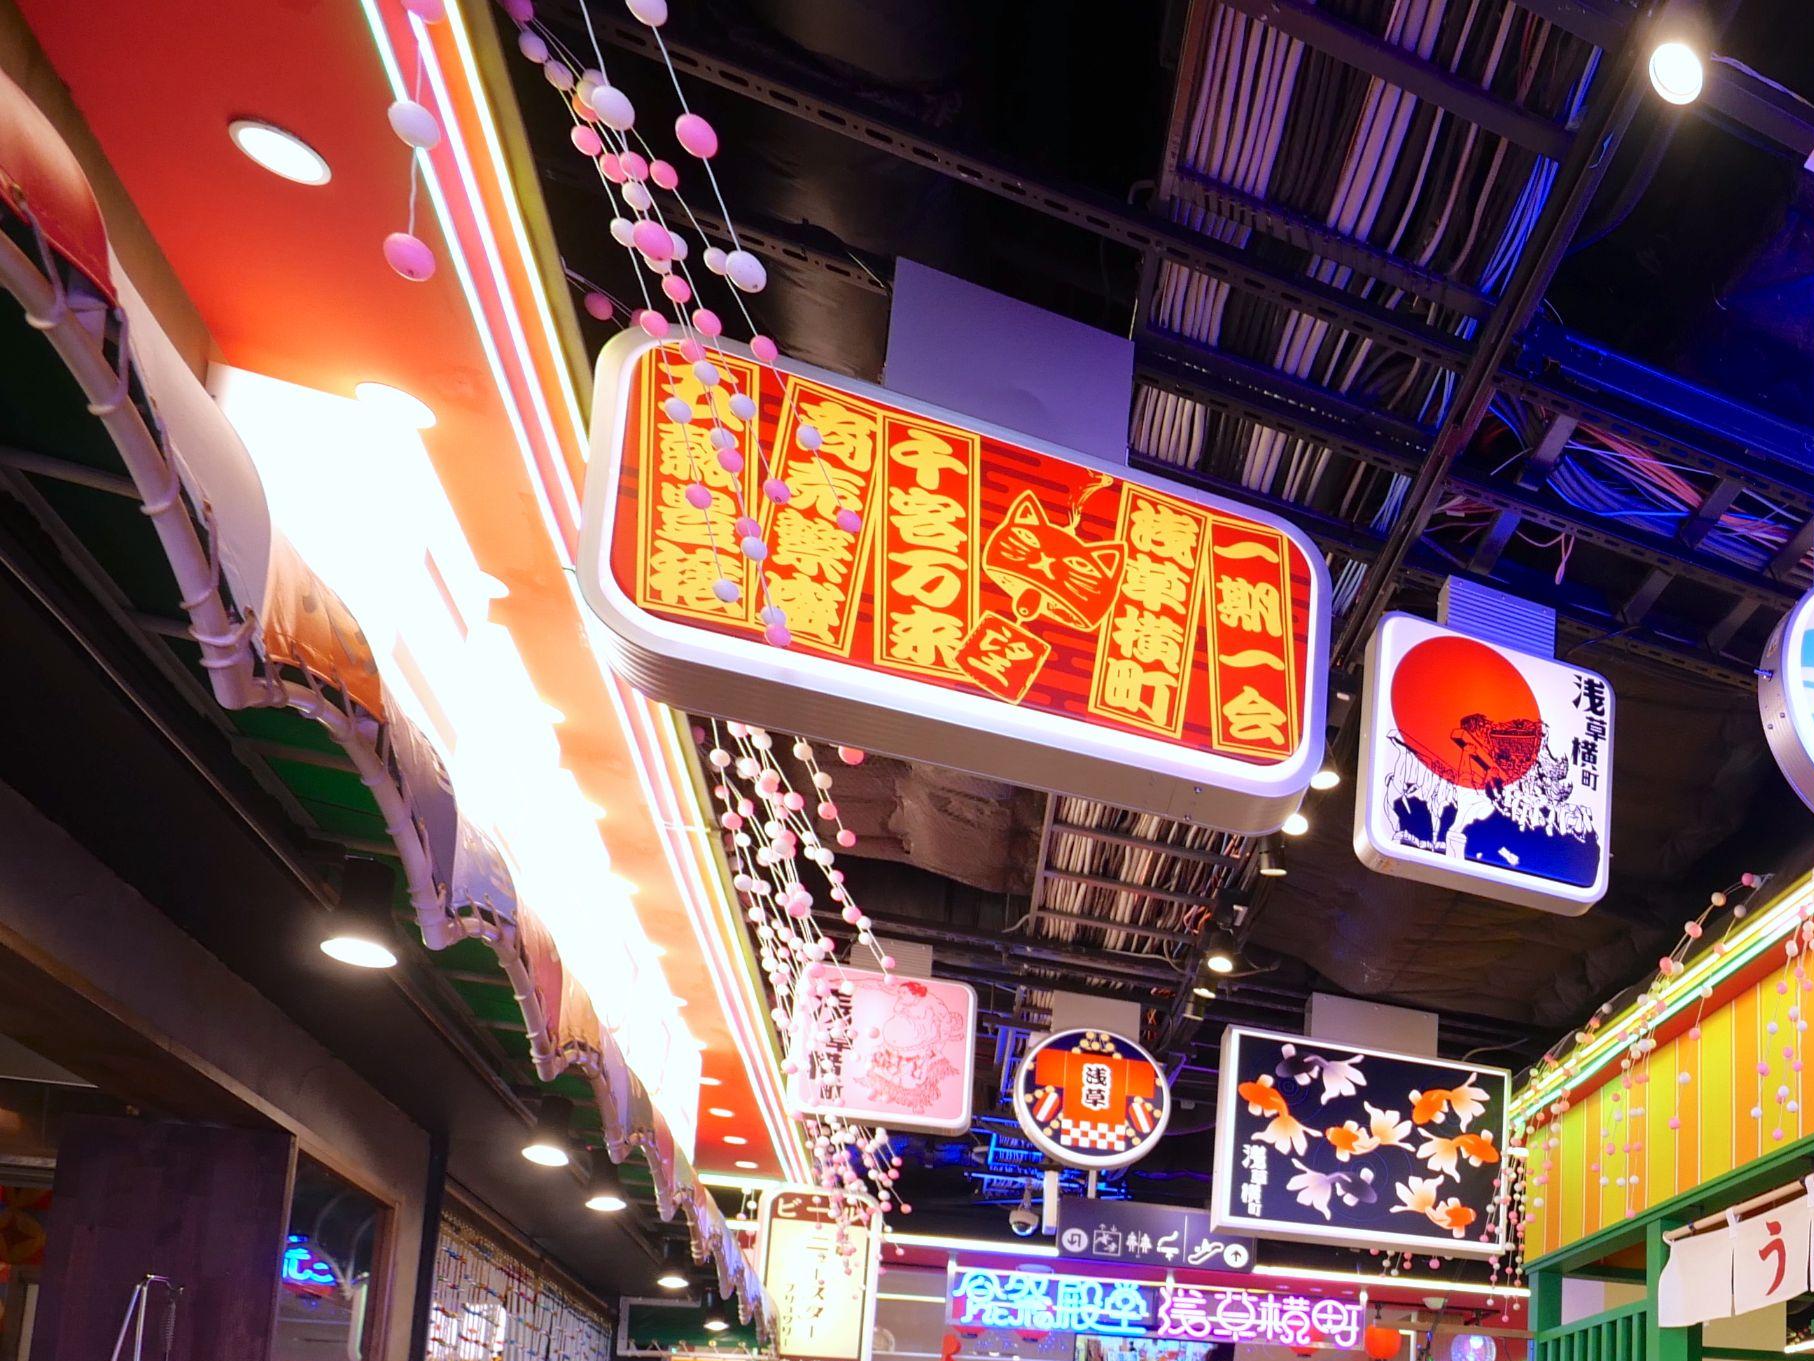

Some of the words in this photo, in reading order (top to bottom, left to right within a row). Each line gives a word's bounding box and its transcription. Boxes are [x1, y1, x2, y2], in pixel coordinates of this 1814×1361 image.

[888, 428, 970, 668] 千客万来
[1104, 498, 1200, 727] 浅草横町
[1213, 540, 1287, 746] 一期一会
[1571, 674, 1607, 792] 浅草横町
[1084, 1064, 1109, 1109] 浅草
[1240, 1143, 1268, 1217] 浅草横町
[1157, 1286, 1365, 1349] 浅草横町
